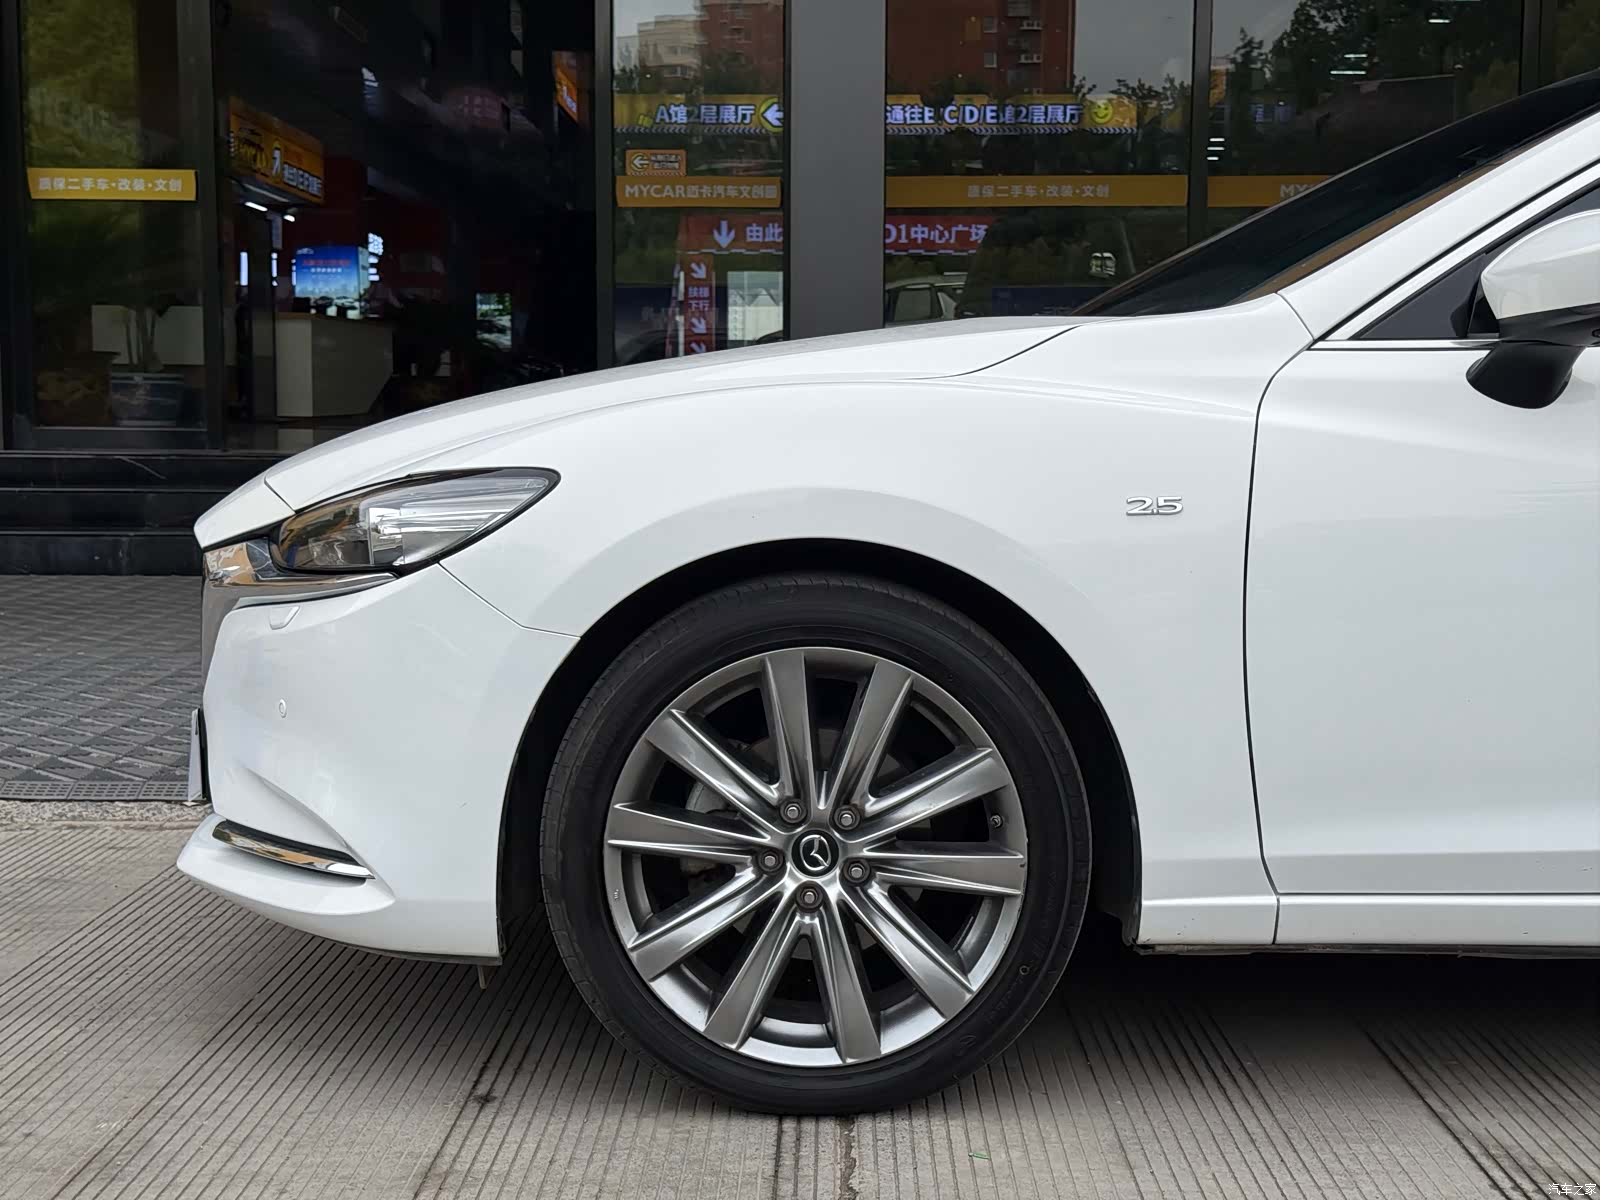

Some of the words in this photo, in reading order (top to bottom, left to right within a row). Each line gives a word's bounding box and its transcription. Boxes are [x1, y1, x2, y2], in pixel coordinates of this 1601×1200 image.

[1280, 184, 1312, 198] MY
[746, 222, 784, 242] 由此
[1126, 496, 1183, 516] 2.5
